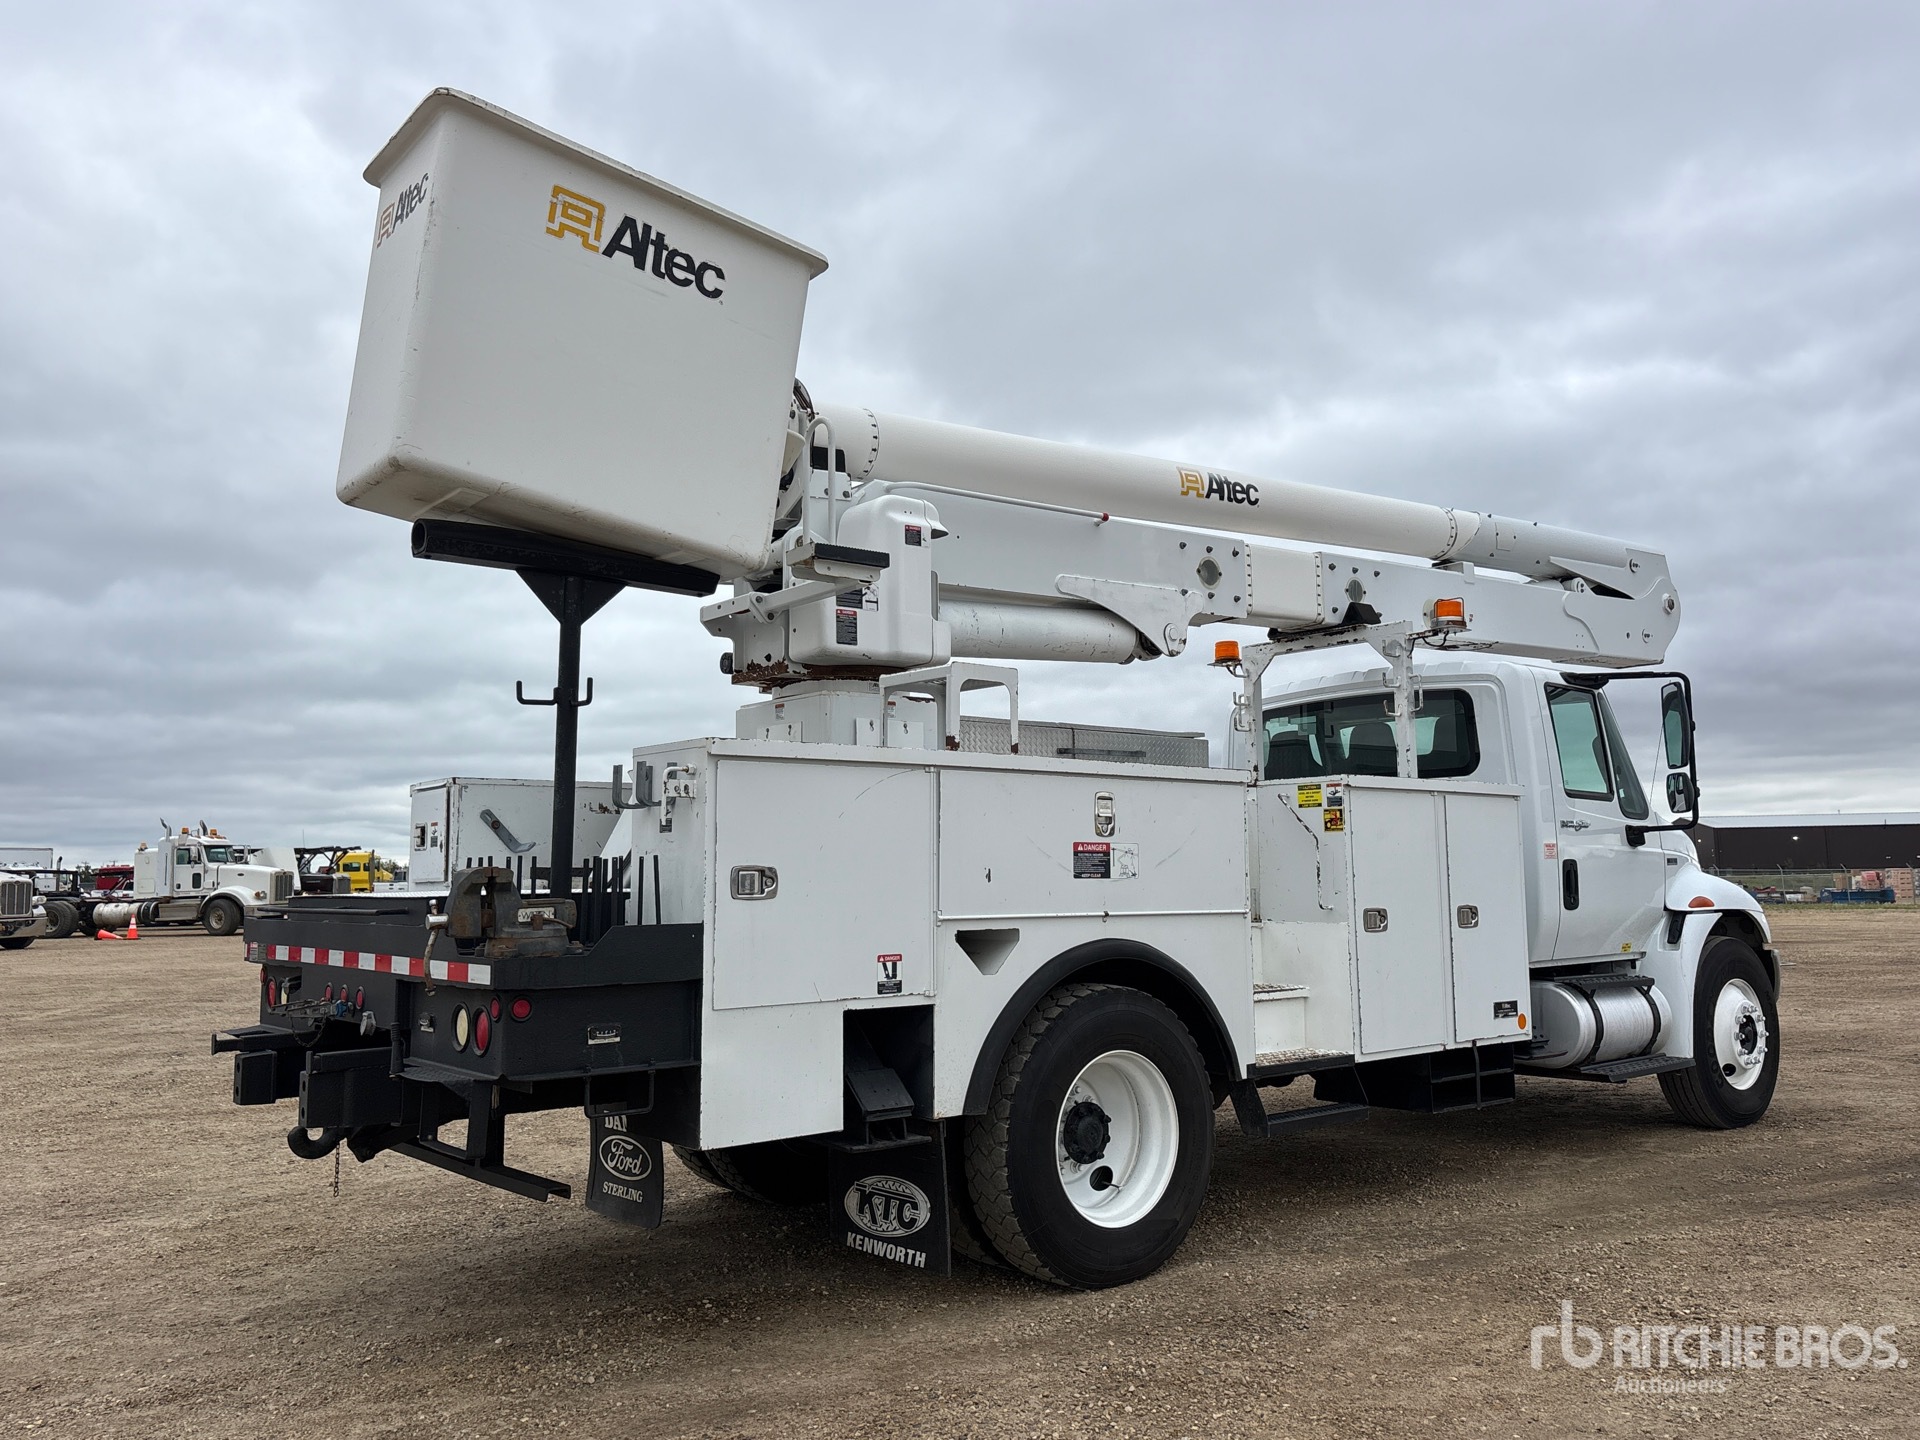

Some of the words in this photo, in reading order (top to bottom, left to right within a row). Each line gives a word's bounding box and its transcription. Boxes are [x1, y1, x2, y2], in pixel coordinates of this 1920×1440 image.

[392, 172, 429, 234] Altec
[602, 212, 726, 300] Altec
[1205, 472, 1260, 506] Altec
[1083, 843, 1107, 851] DANGER
[607, 1139, 643, 1175] Ford
[602, 1181, 643, 1203] STERLING
[854, 1181, 921, 1231] KTC
[846, 1231, 927, 1268] KENWORTH
